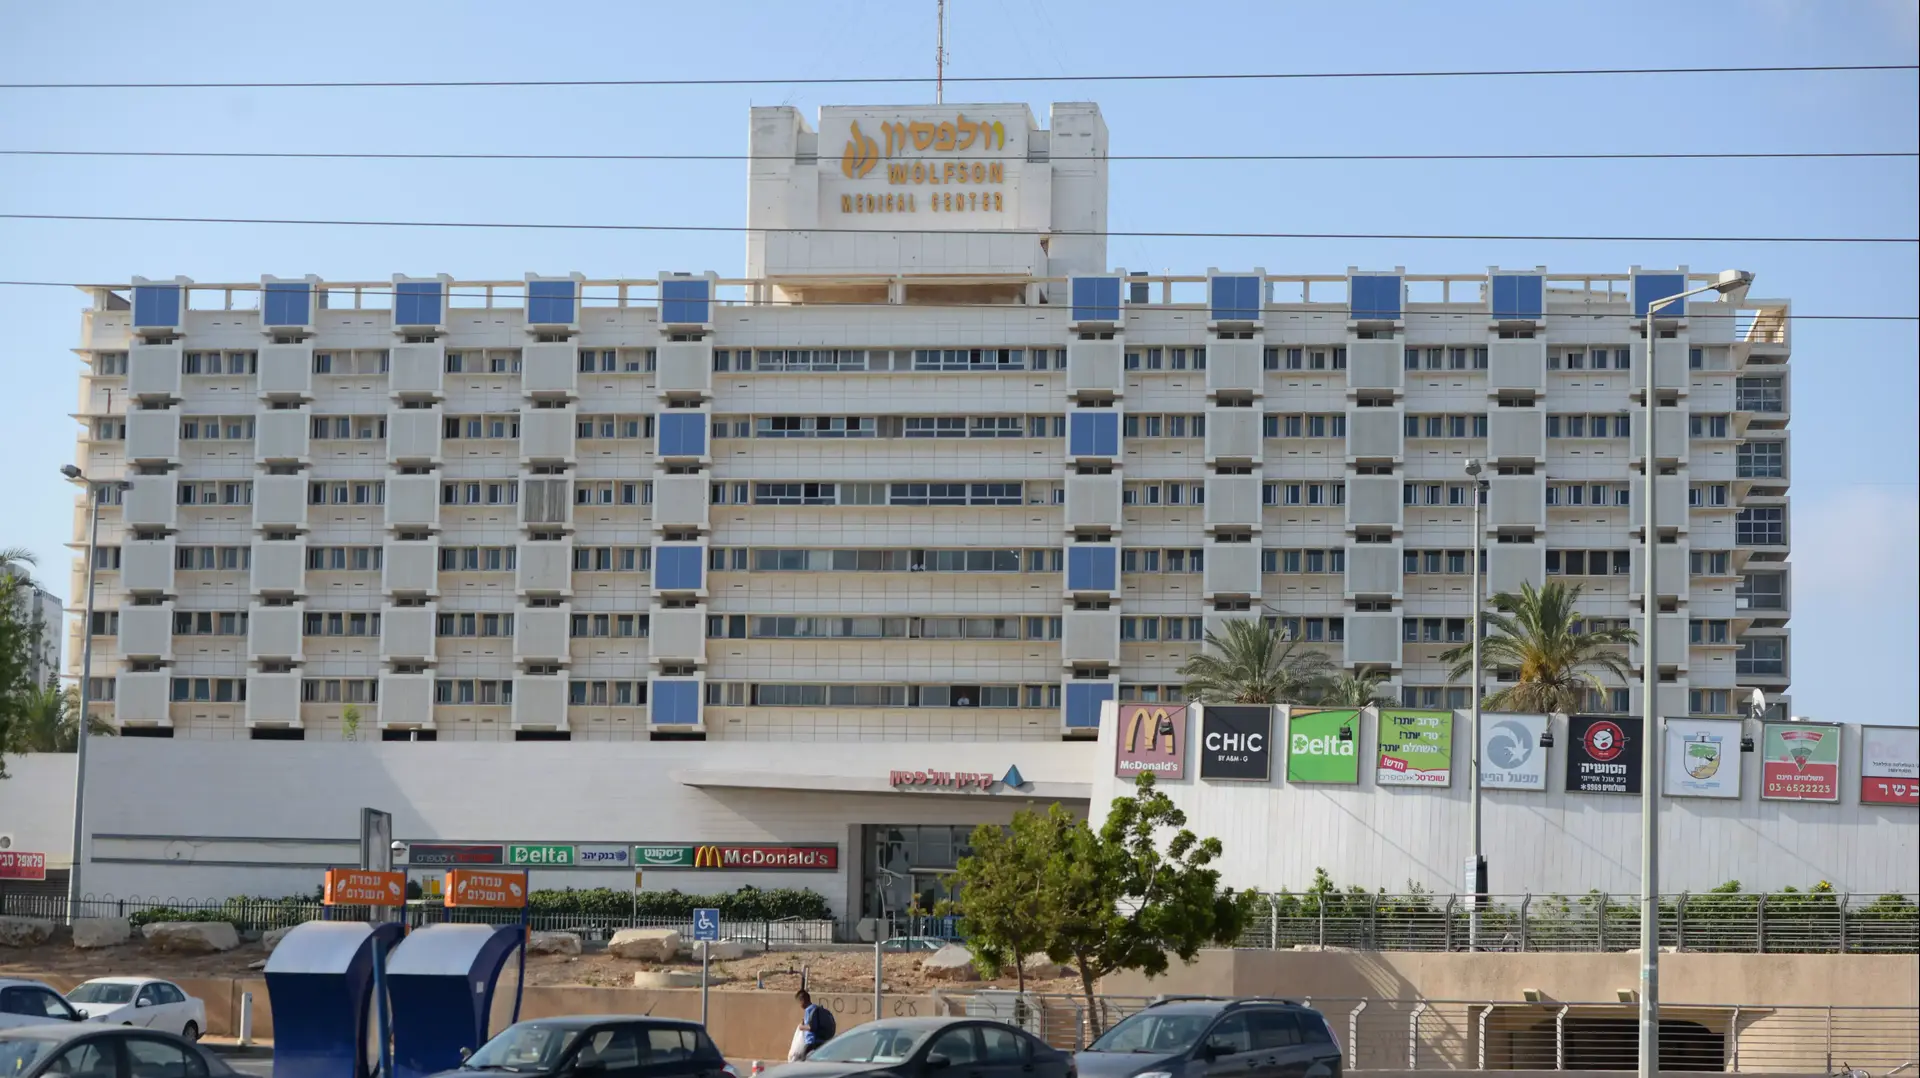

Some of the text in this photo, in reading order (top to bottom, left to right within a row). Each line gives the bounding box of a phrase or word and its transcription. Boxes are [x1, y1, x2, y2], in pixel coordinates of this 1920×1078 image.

[881, 114, 1005, 158] וולפסון
[888, 161, 1004, 185] WOLFSON
[841, 191, 1003, 213] MEDICAL CENTER
[1205, 732, 1263, 752] CHIC
[1291, 733, 1354, 756] Delta
[1120, 760, 1178, 771] McDonald's
[1383, 757, 1404, 770] חדש!
[1580, 762, 1627, 775] הסושיה
[889, 768, 994, 790] קניון וולפסון
[1415, 773, 1446, 782] שופרסל
[1508, 771, 1539, 784] מפעל
[1768, 783, 1831, 793] 03-6522223
[17, 853, 43, 868] פלאפל
[514, 847, 569, 863] Delta
[581, 851, 615, 862] בנק יהב
[643, 848, 684, 860] דיסקונט
[724, 849, 829, 865] McDonald's
[346, 887, 385, 900] תשלום
[467, 889, 506, 901] תשלום
